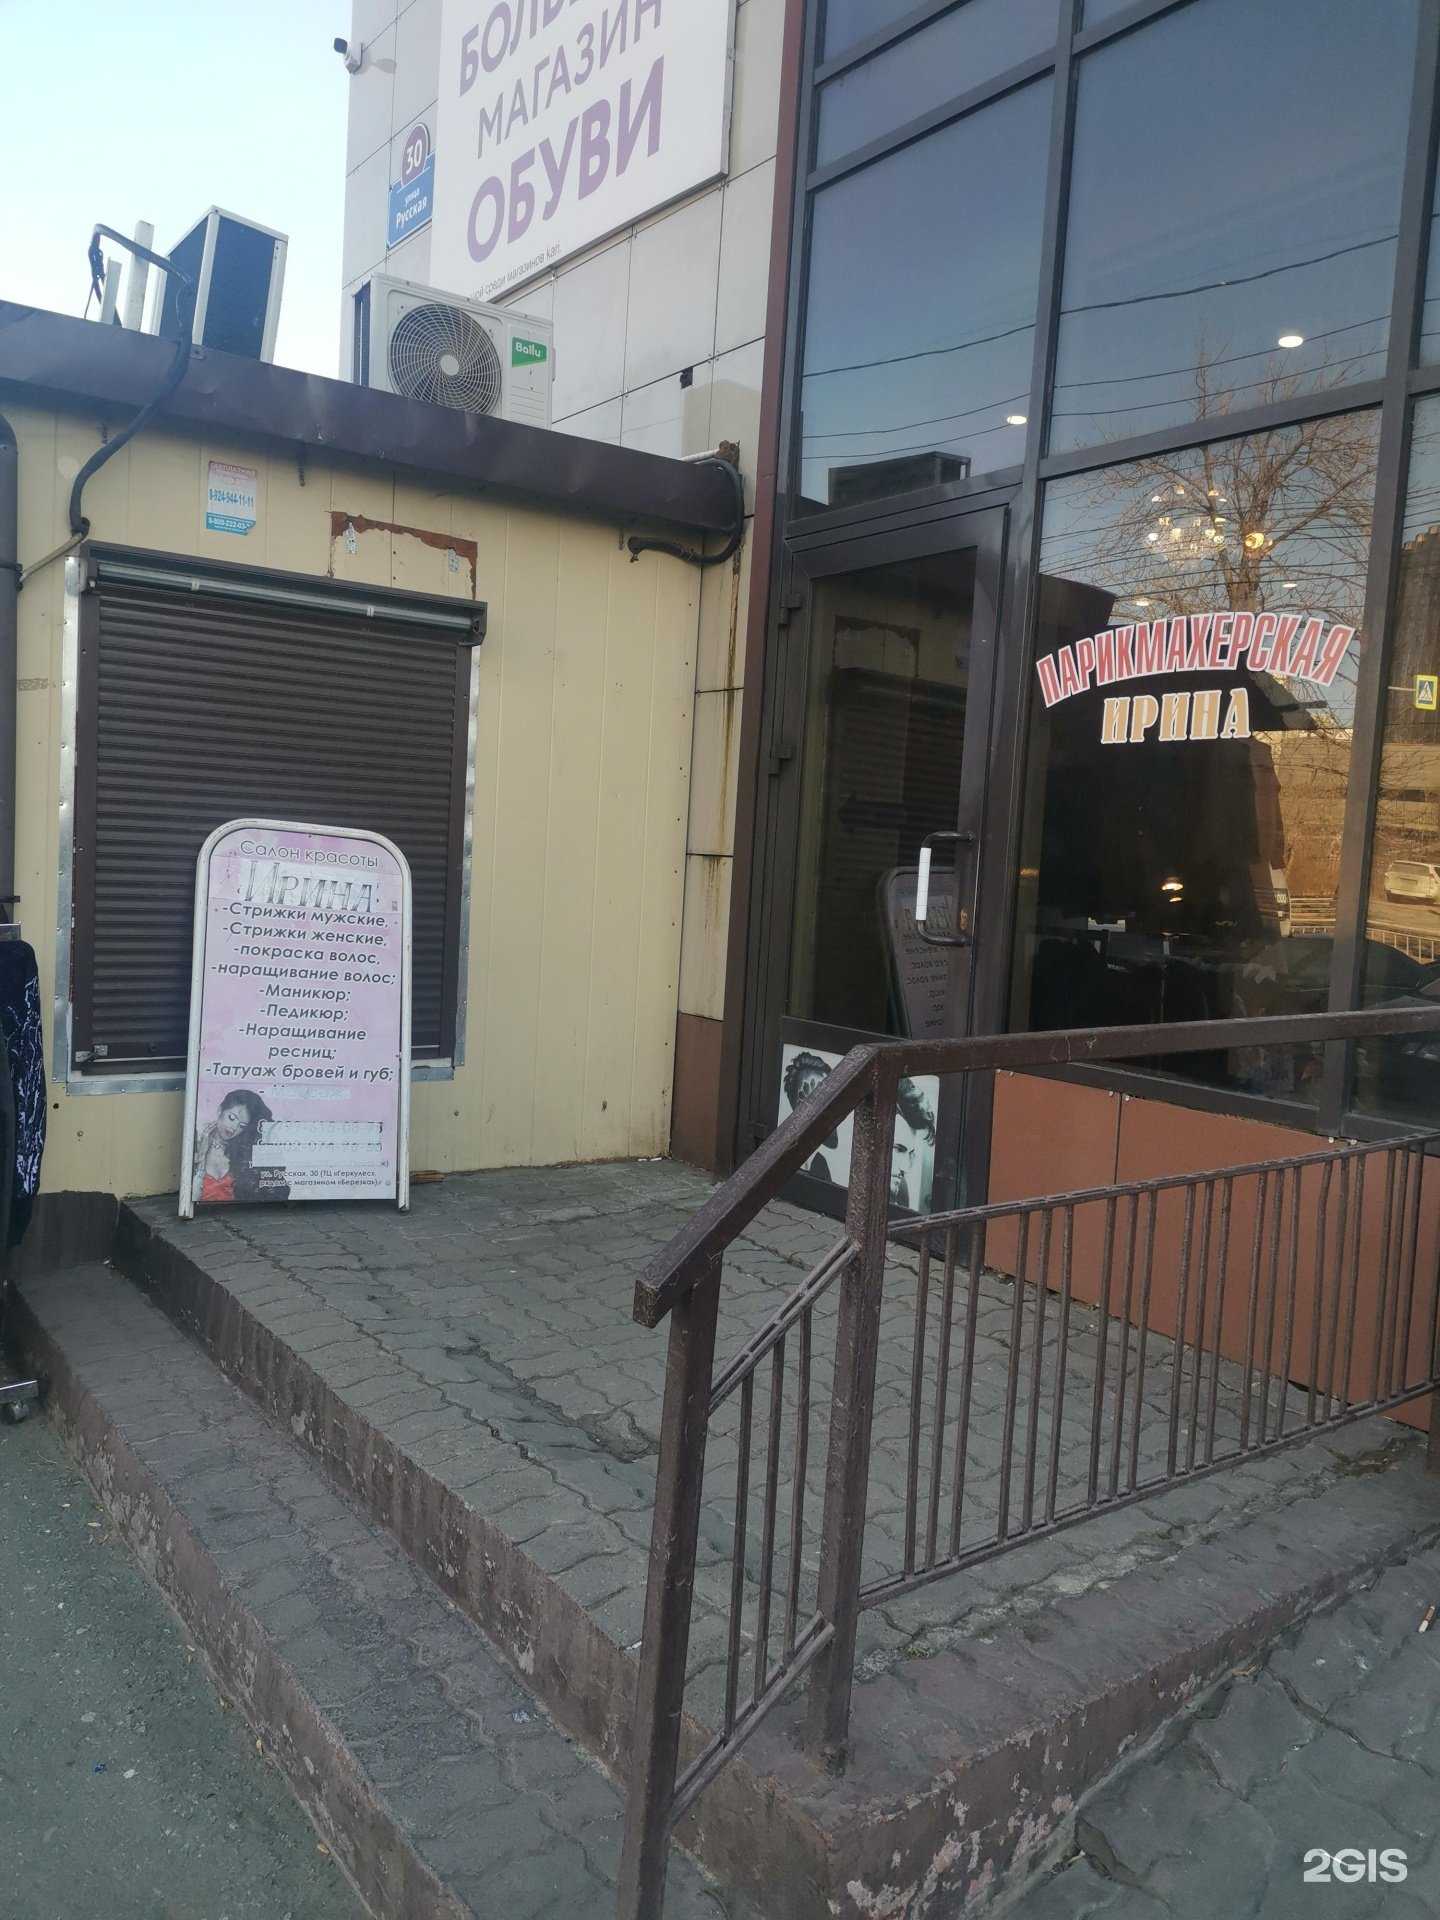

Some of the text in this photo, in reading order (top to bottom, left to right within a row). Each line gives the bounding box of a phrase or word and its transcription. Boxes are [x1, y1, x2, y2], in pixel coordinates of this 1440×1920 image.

[476, 0, 662, 160] МАГАЗИН
[405, 139, 423, 175] 30
[466, 54, 665, 264] ОБУВИ
[395, 196, 428, 230] Русская
[515, 342, 541, 357] Ballu
[1036, 611, 1356, 708] ПАРИКМАХЕРСКАЯ
[1101, 687, 1252, 744] ИРИНА
[240, 840, 378, 868] Салон красоты
[222, 902, 306, 919] -Стрижки
[222, 922, 307, 939] -Стрижки
[233, 945, 324, 960] -покраска
[211, 962, 339, 981] -наращивание
[259, 984, 351, 1002] -Маникюр;
[260, 1003, 349, 1022] -Педикюр;
[239, 1023, 367, 1041] -Наращивание
[267, 1045, 337, 1060] ресниц;
[205, 1062, 394, 1082] -Татуаж бровей и губ;
